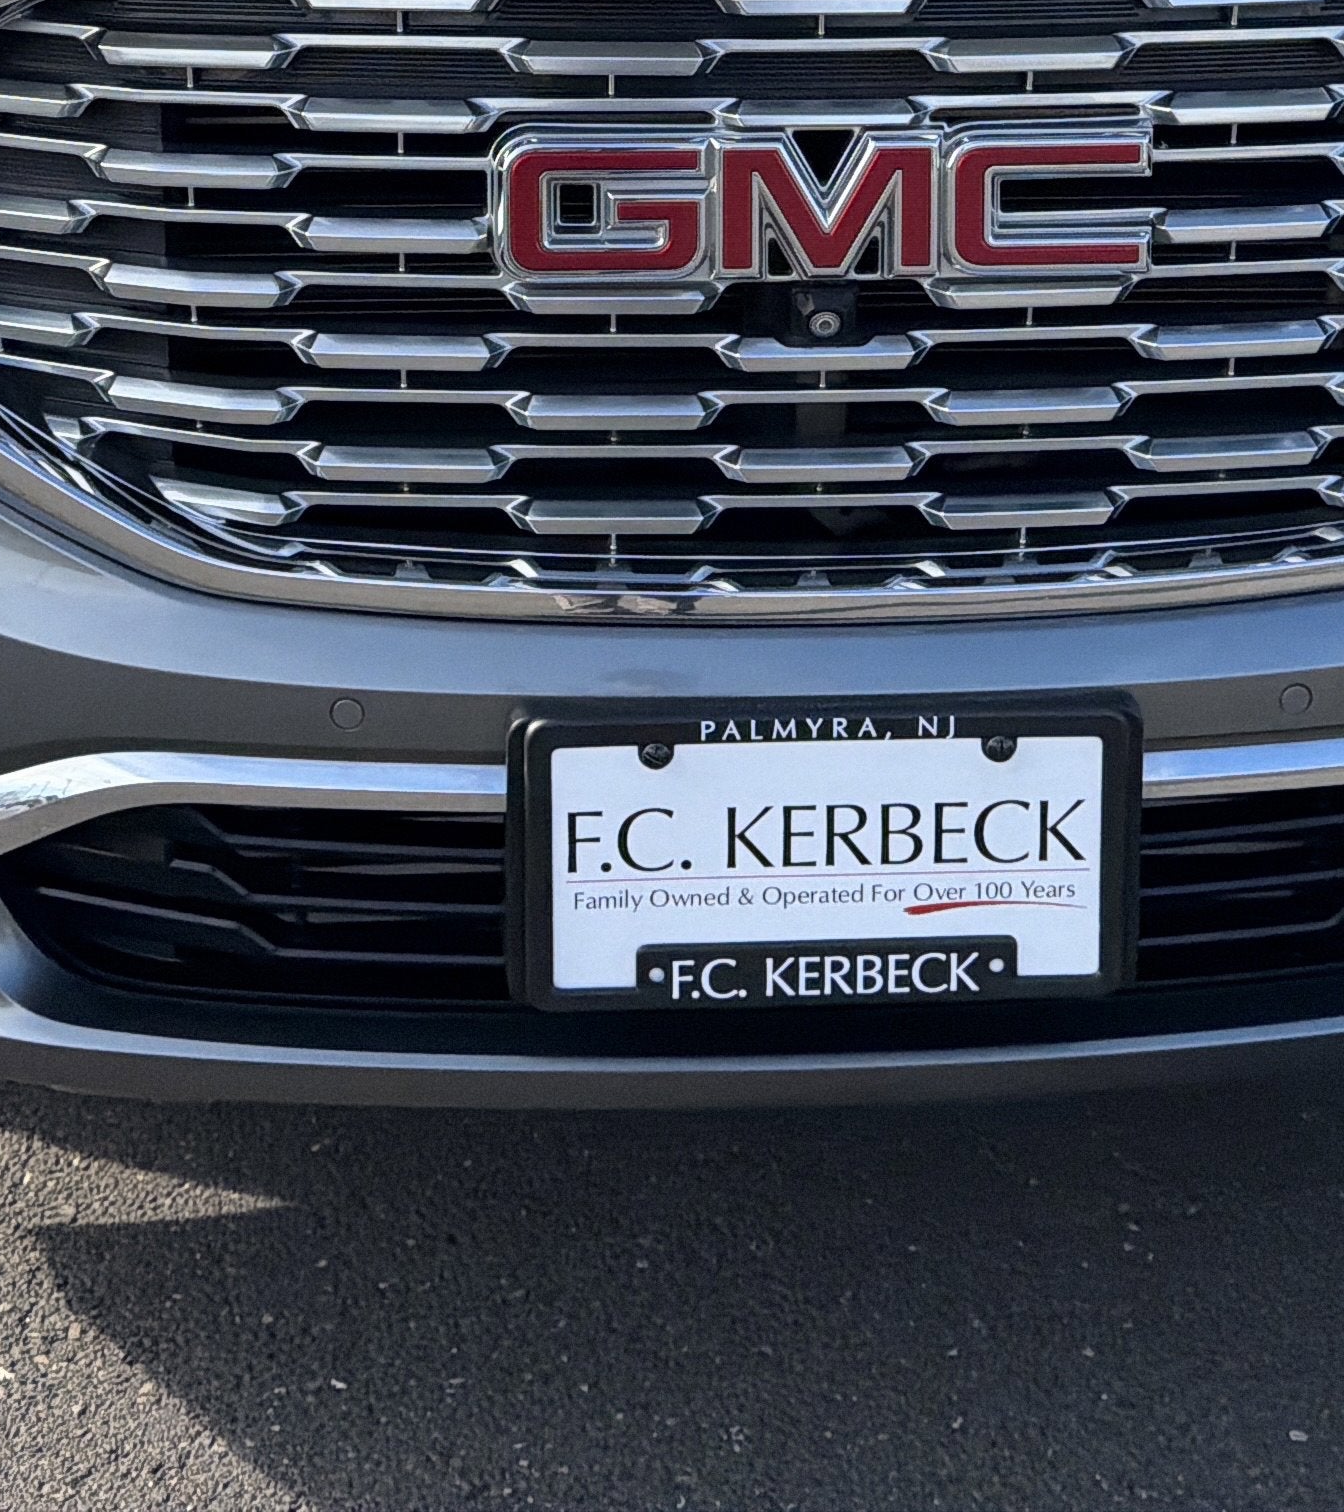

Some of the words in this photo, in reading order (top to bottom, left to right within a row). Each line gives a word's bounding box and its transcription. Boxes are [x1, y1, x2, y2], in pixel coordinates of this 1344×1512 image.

[491, 122, 1152, 280] GMC
[700, 717, 894, 741] PALMYRA,
[918, 715, 956, 739] NJ
[567, 807, 692, 873] F.C.
[726, 799, 1086, 869] KERBECK
[574, 890, 643, 912] Family
[649, 886, 730, 907] Owned
[738, 888, 753, 905] &
[762, 883, 864, 911] Operated
[871, 883, 905, 902] For
[913, 882, 966, 901] Over
[975, 882, 1012, 899] 100
[1020, 880, 1075, 899] Years
[671, 958, 747, 1000] F.C.
[765, 951, 980, 997] KERBECK
